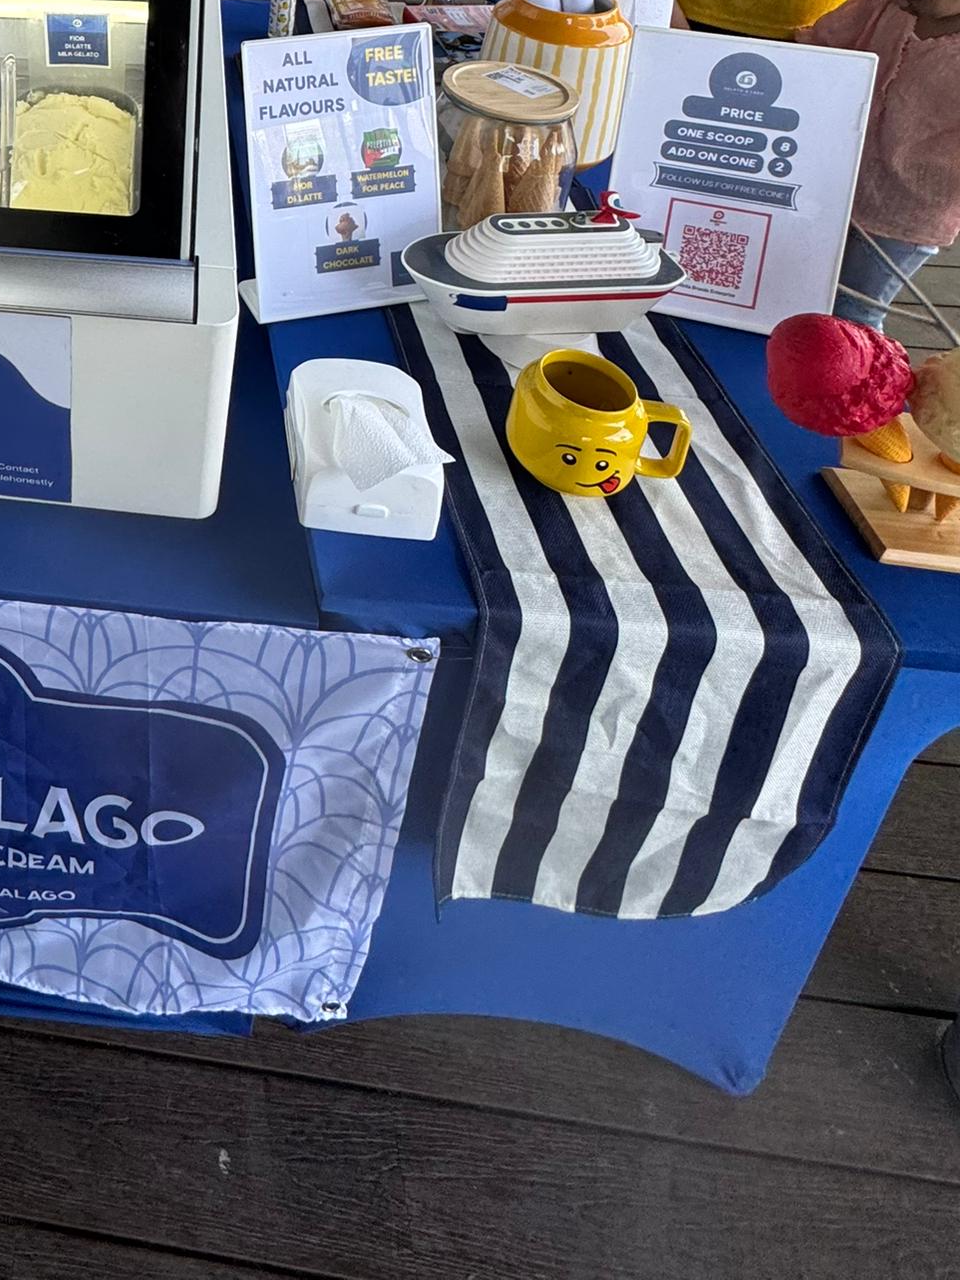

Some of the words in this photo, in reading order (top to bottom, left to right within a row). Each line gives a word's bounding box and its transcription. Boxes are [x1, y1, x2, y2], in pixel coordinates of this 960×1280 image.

[282, 50, 312, 67] ALL
[364, 45, 404, 63] FREE
[263, 73, 339, 94] NATURAL
[365, 67, 417, 88] TASTE!
[259, 97, 345, 120] FLAVOURS
[720, 106, 765, 122] PRICE
[677, 127, 705, 139] ONE
[706, 131, 754, 146] SCOOP
[780, 142, 791, 152] 8
[666, 146, 696, 158] ADD
[698, 151, 718, 161] ON
[719, 154, 758, 168] CONE
[774, 162, 785, 172] 2
[356, 169, 410, 183] WATERMELON
[362, 184, 378, 193] FOR
[379, 181, 406, 191] PEACE
[661, 172, 701, 186] FOLLOW
[701, 179, 714, 188] US
[714, 182, 735, 191] FOR
[734, 184, 757, 194] FREE
[757, 188, 784, 200] CONE
[336, 245, 360, 256] DARK
[323, 256, 374, 270] CHOCOLATE
